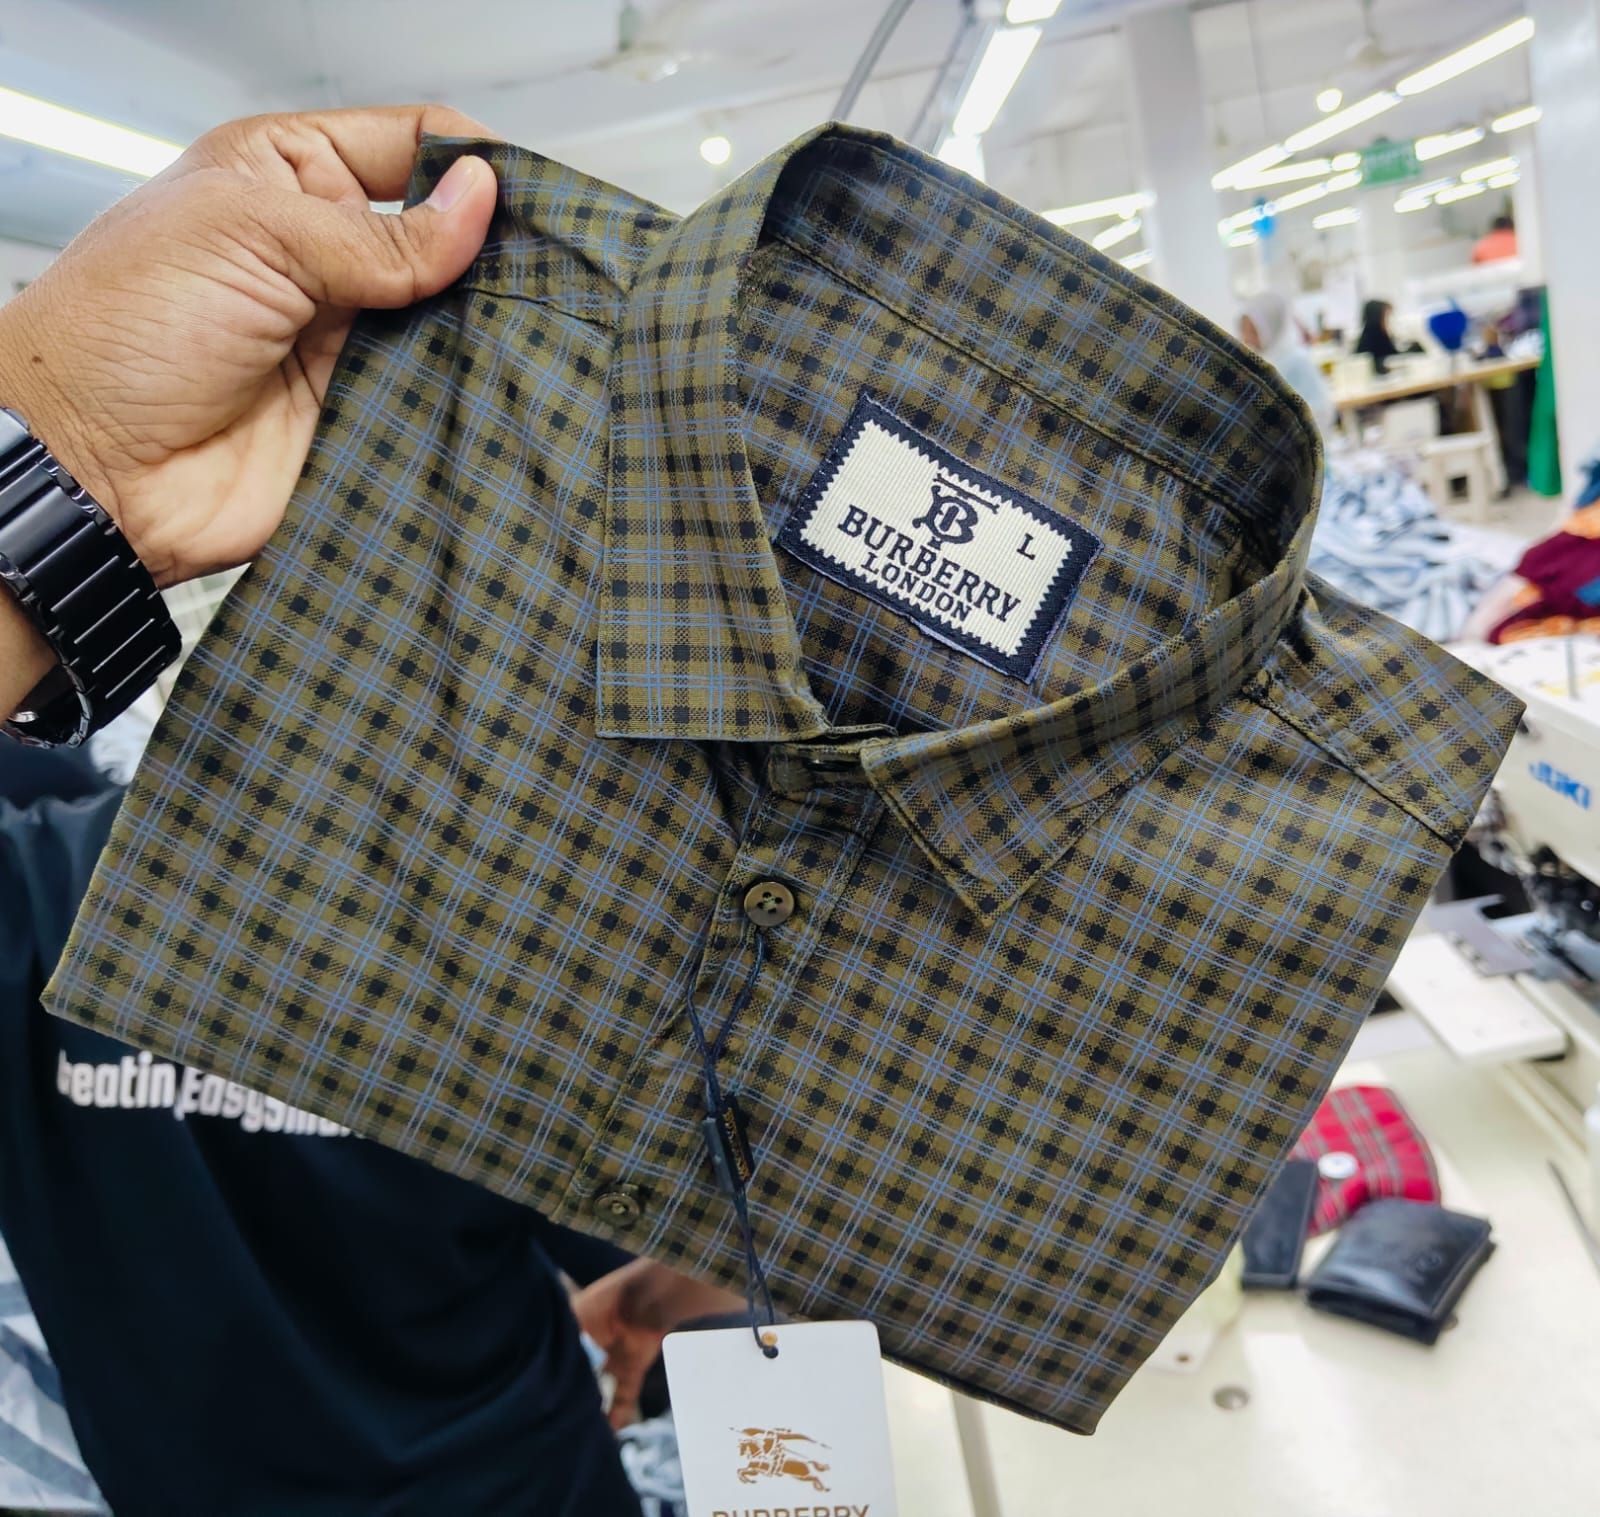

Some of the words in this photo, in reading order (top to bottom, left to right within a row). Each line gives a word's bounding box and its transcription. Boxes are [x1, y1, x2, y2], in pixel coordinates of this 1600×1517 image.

[837, 504, 1021, 623] BURBERRY
[1016, 532, 1036, 561] L
[860, 552, 973, 623] LONDON
